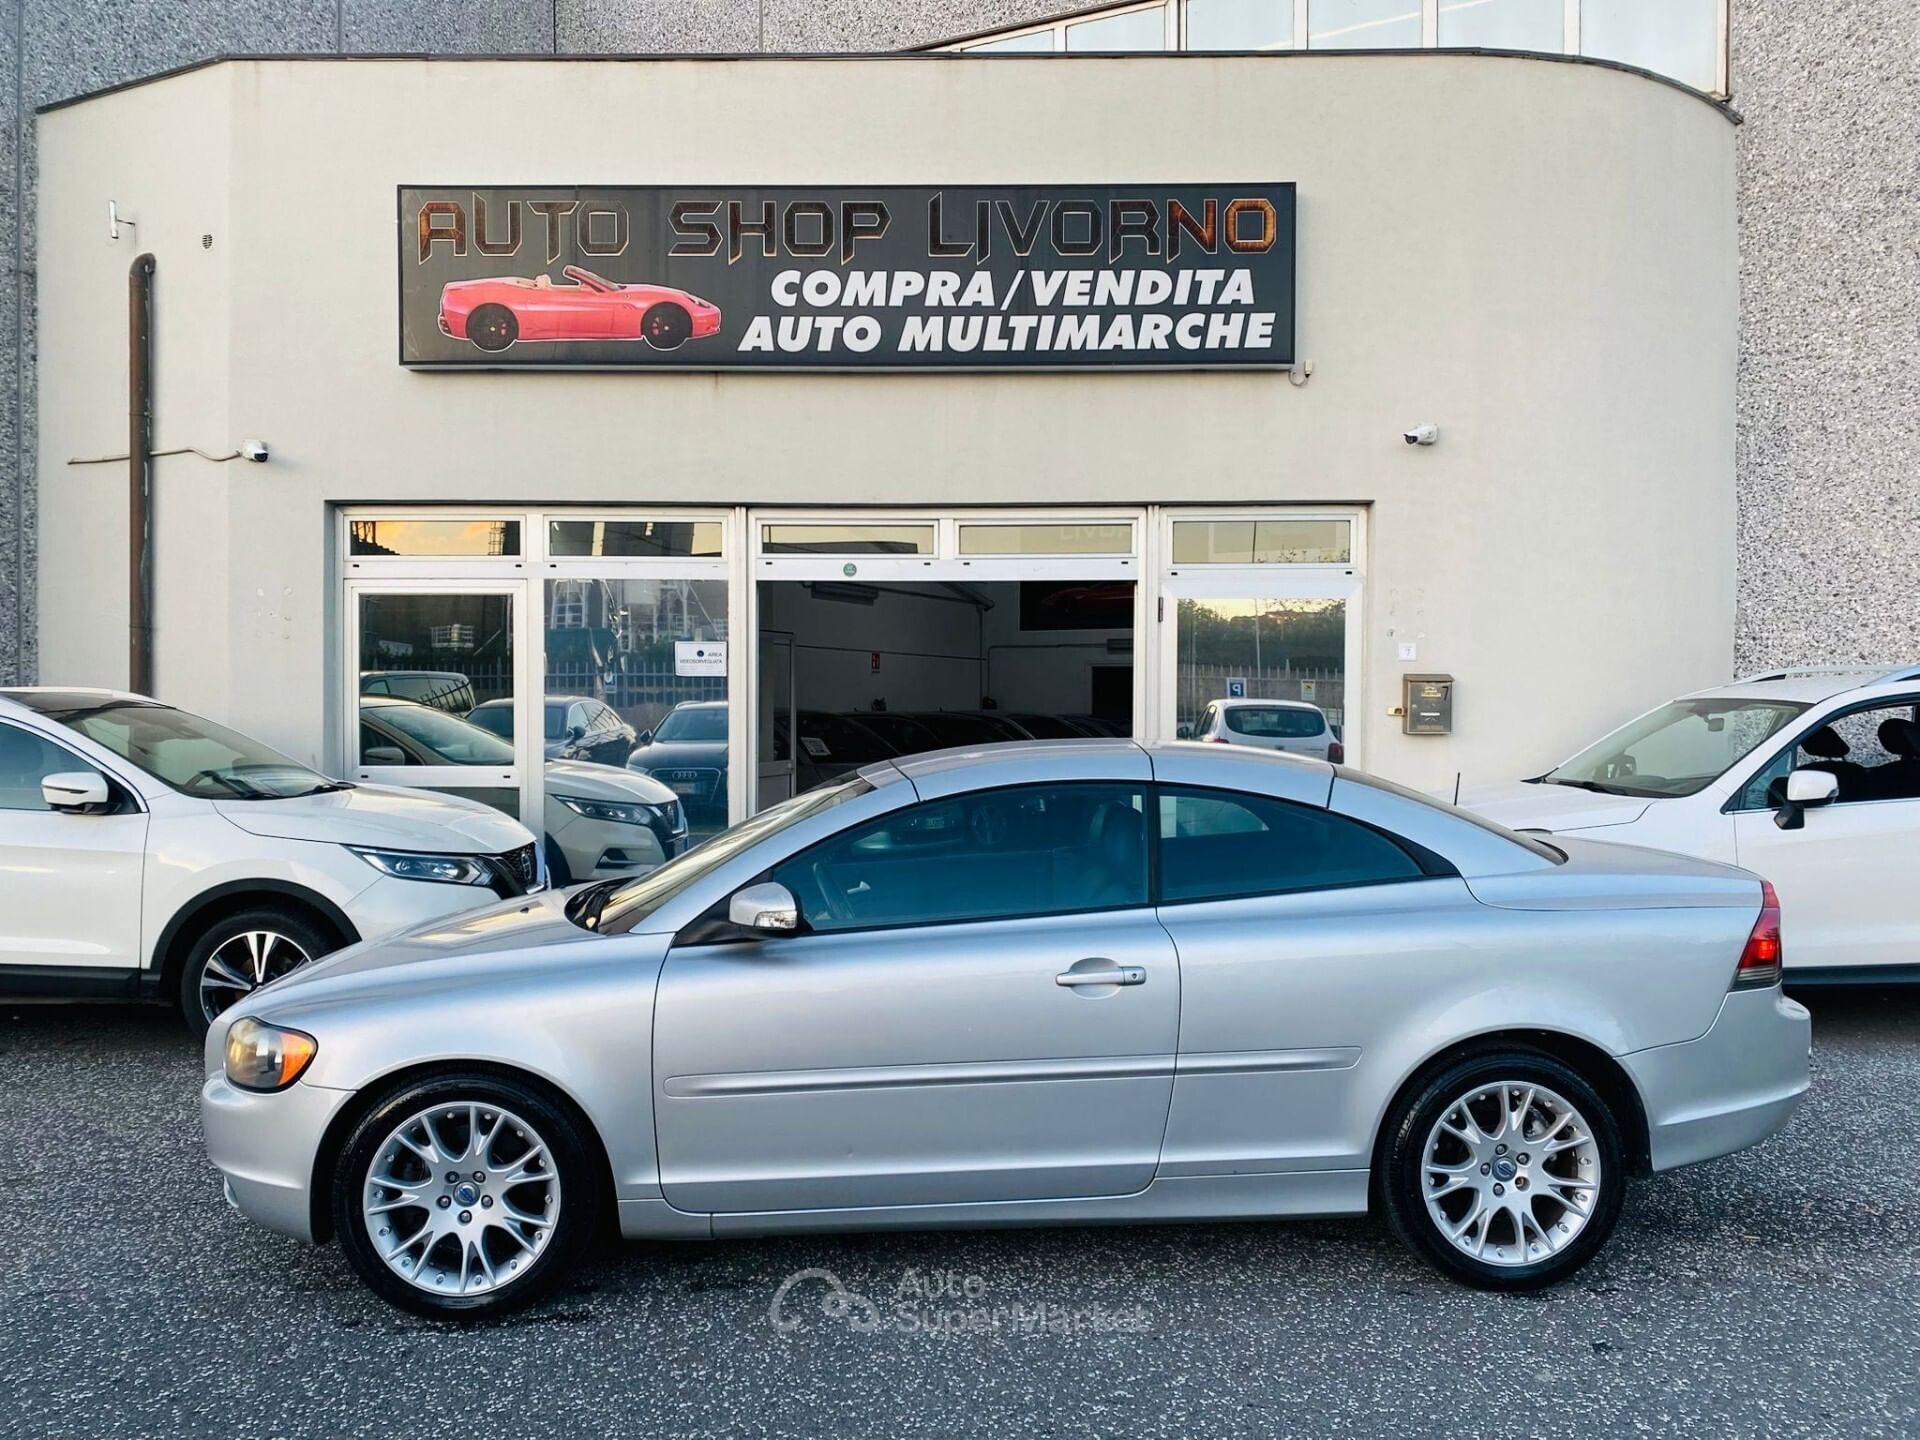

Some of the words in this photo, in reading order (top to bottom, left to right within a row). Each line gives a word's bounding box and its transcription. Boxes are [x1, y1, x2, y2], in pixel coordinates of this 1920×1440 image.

[418, 192, 630, 265] AUTO
[667, 200, 892, 265] SHOP
[927, 191, 1277, 265] LIVORNO
[770, 268, 1256, 311] COMPRA/VENDITA
[736, 314, 882, 354] AUTO
[897, 311, 1277, 353] MULTIMARCHE
